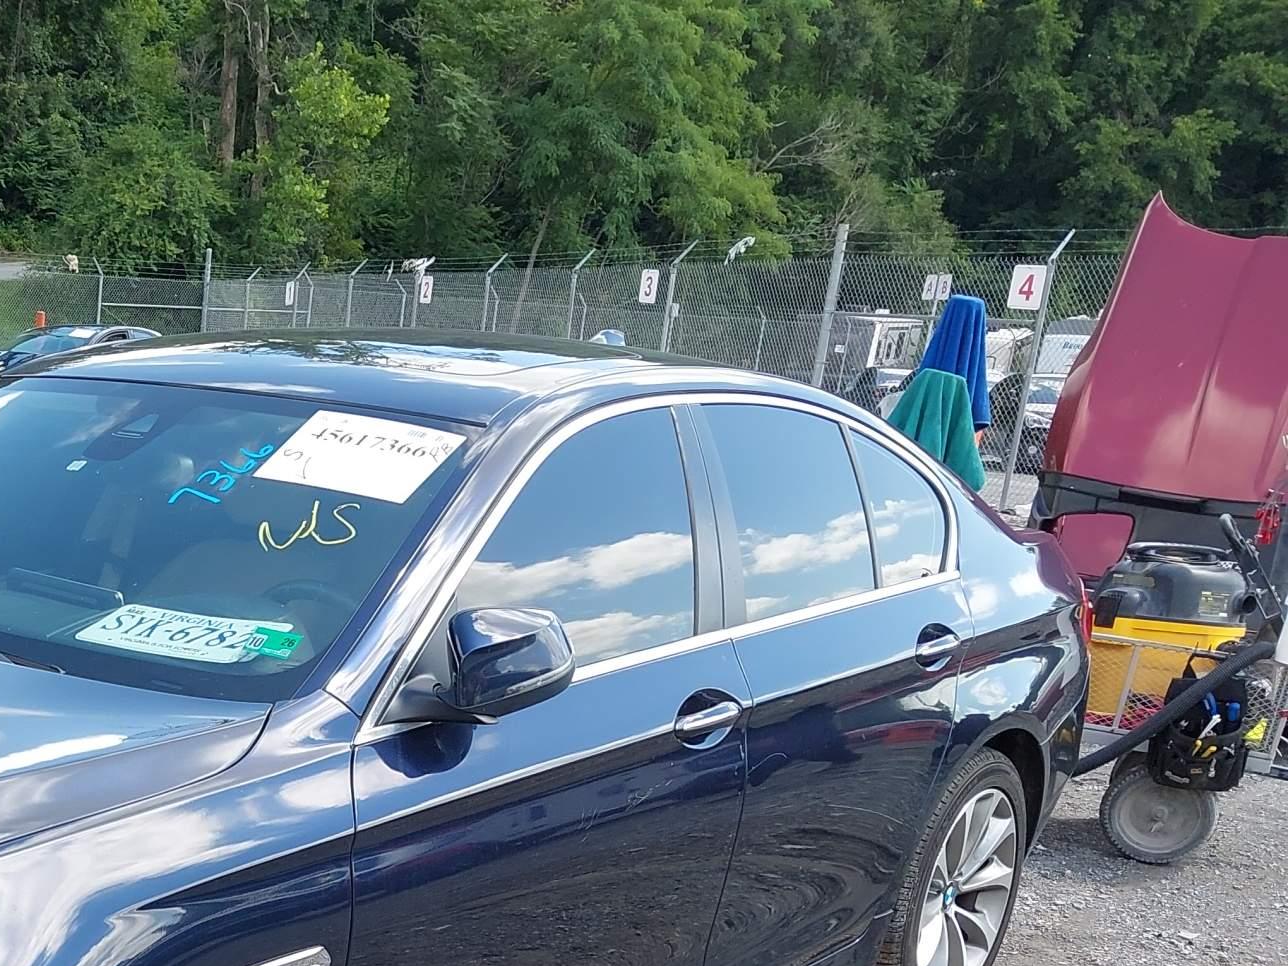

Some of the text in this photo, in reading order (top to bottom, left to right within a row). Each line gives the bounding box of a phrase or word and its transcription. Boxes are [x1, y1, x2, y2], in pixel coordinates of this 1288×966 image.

[423, 281, 431, 299] 2
[644, 276, 654, 297] 3
[1017, 273, 1036, 302] 4
[311, 427, 427, 458] 45617366
[167, 444, 274, 505] 7366
[100, 613, 253, 650] SYK-6782
[159, 612, 235, 630] VIRGINIA
[248, 636, 265, 648] 10
[280, 637, 297, 648] 26
